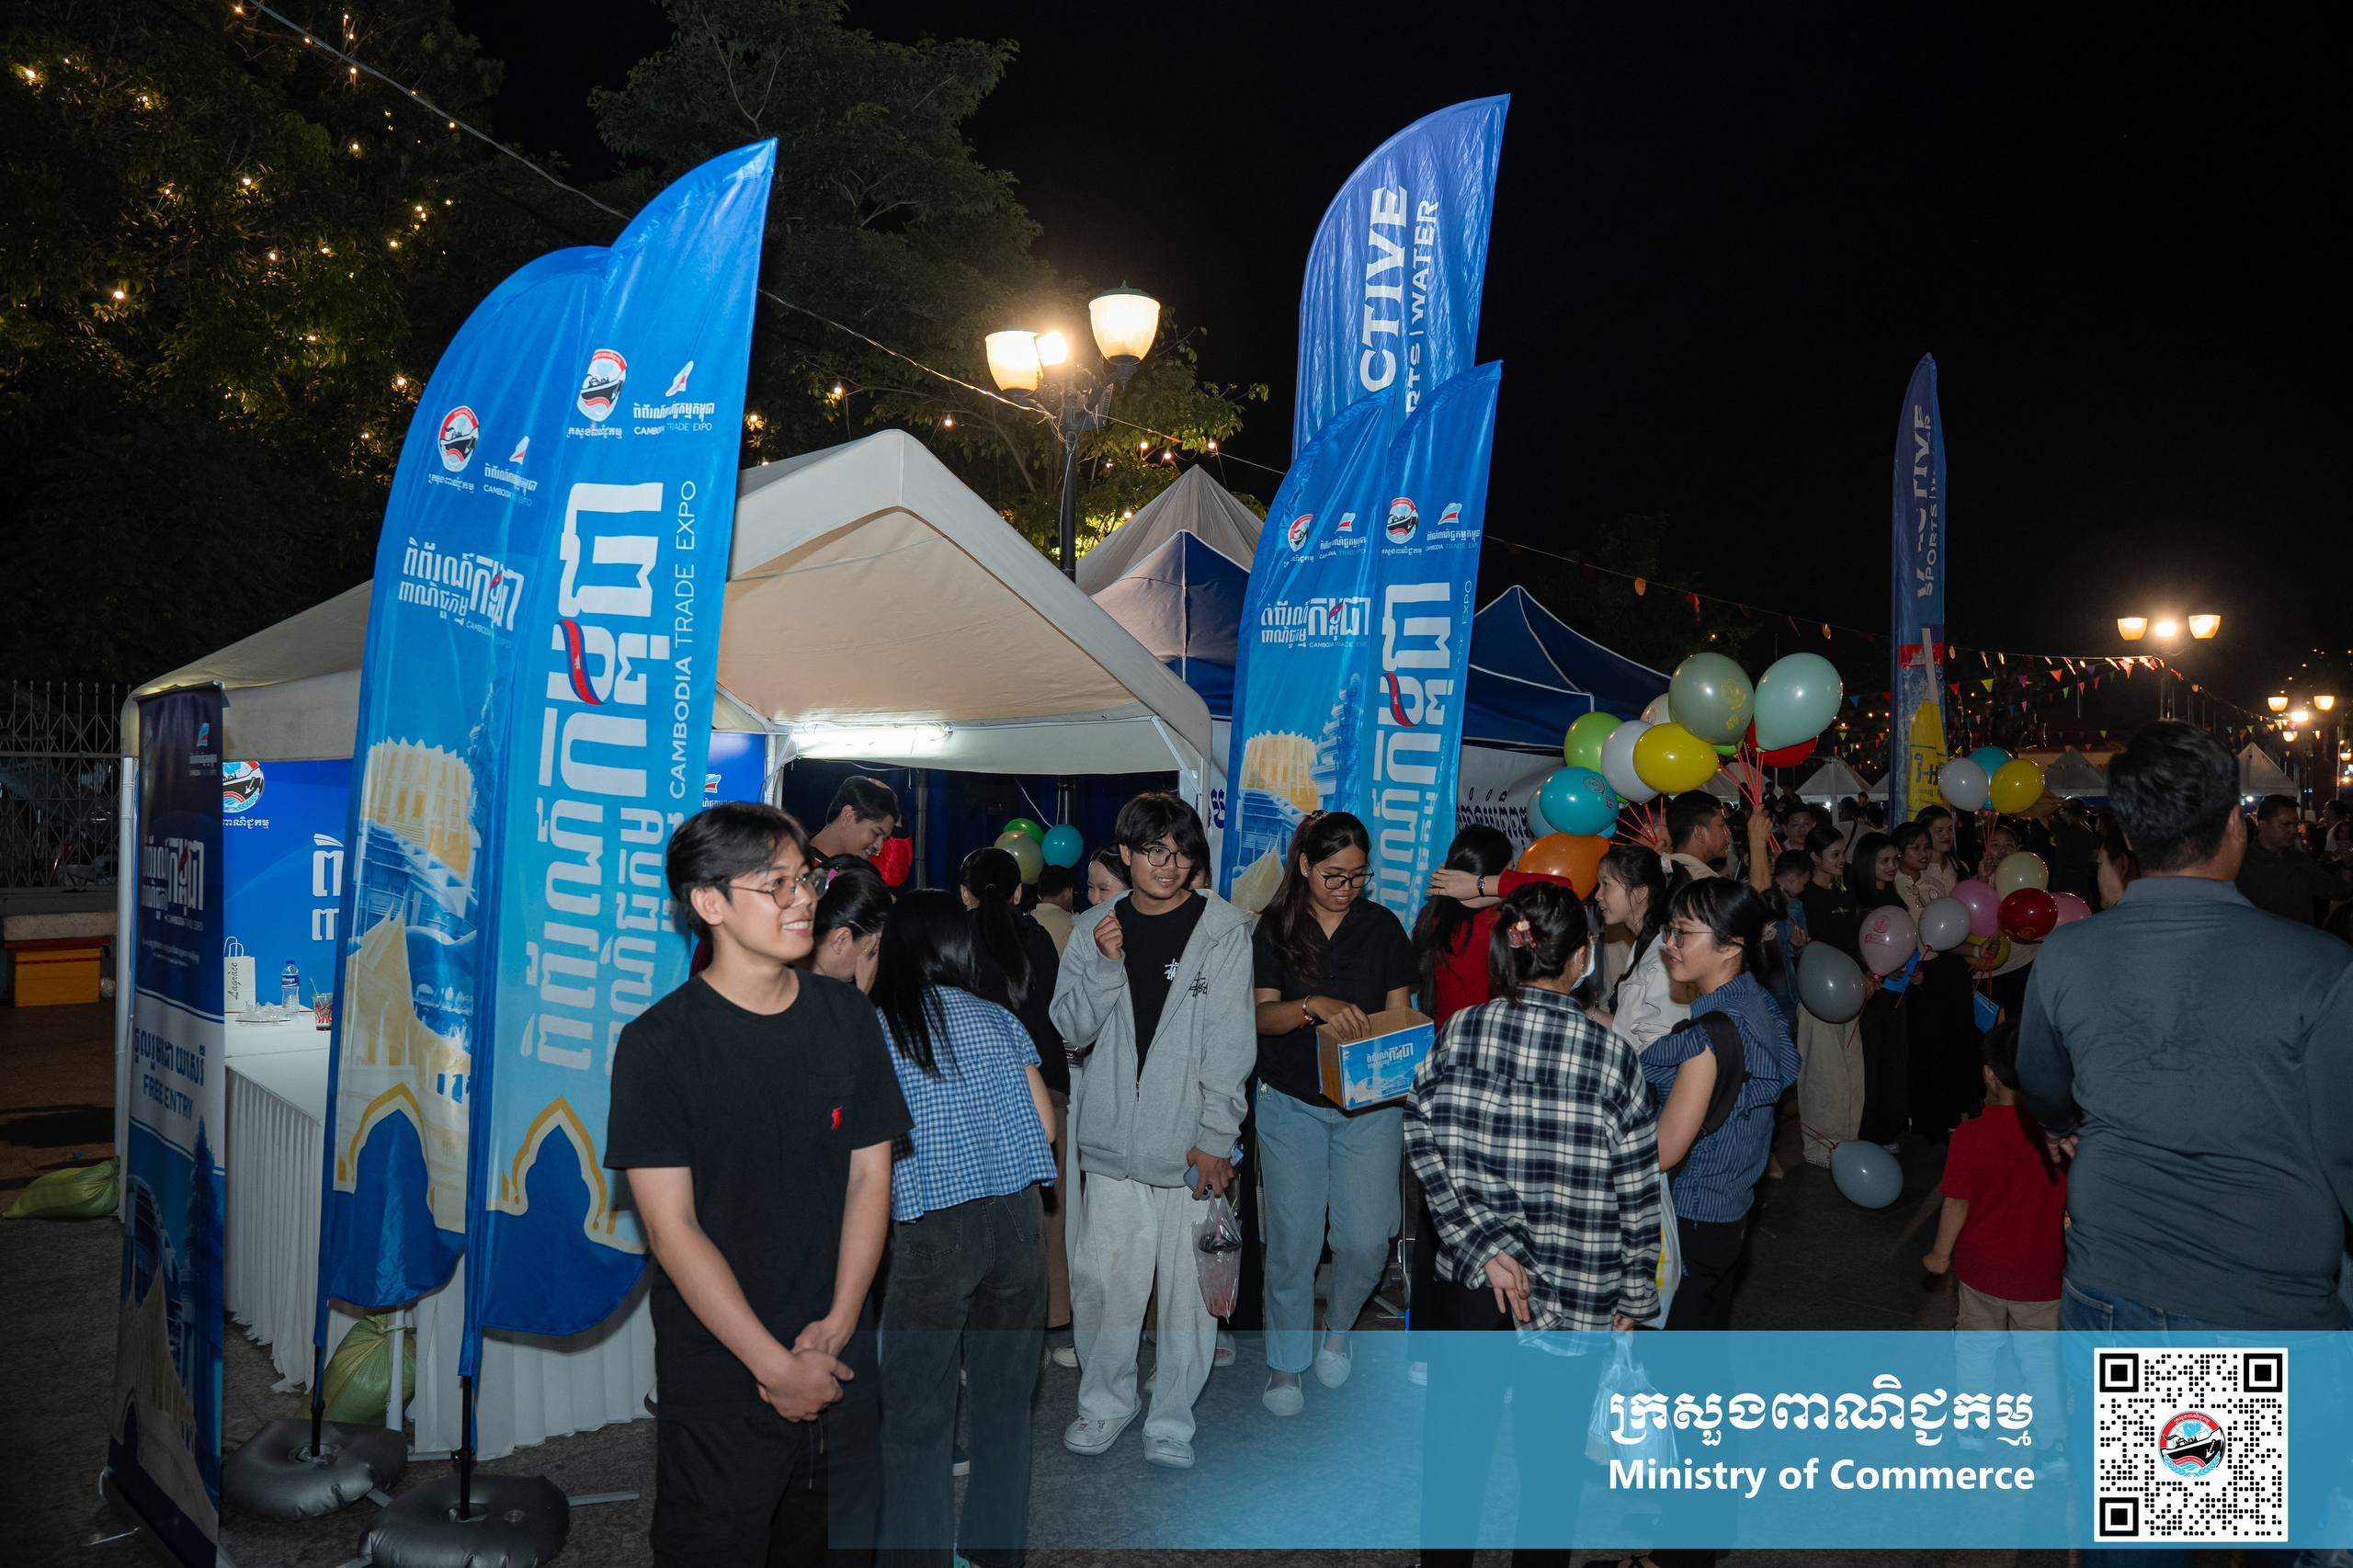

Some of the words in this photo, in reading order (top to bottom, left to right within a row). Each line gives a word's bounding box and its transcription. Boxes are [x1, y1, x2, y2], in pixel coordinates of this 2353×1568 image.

[1359, 185, 1408, 392] CTIVE
[1411, 199, 1441, 323] WATER
[1405, 342, 1423, 414] RTS
[693, 422, 712, 432] EXPO
[676, 481, 697, 551] EXPO
[674, 563, 695, 648] TRADE
[670, 656, 692, 799] CAMBODIA
[143, 1073, 164, 1105] FREE
[164, 1085, 194, 1120] ENTRY
